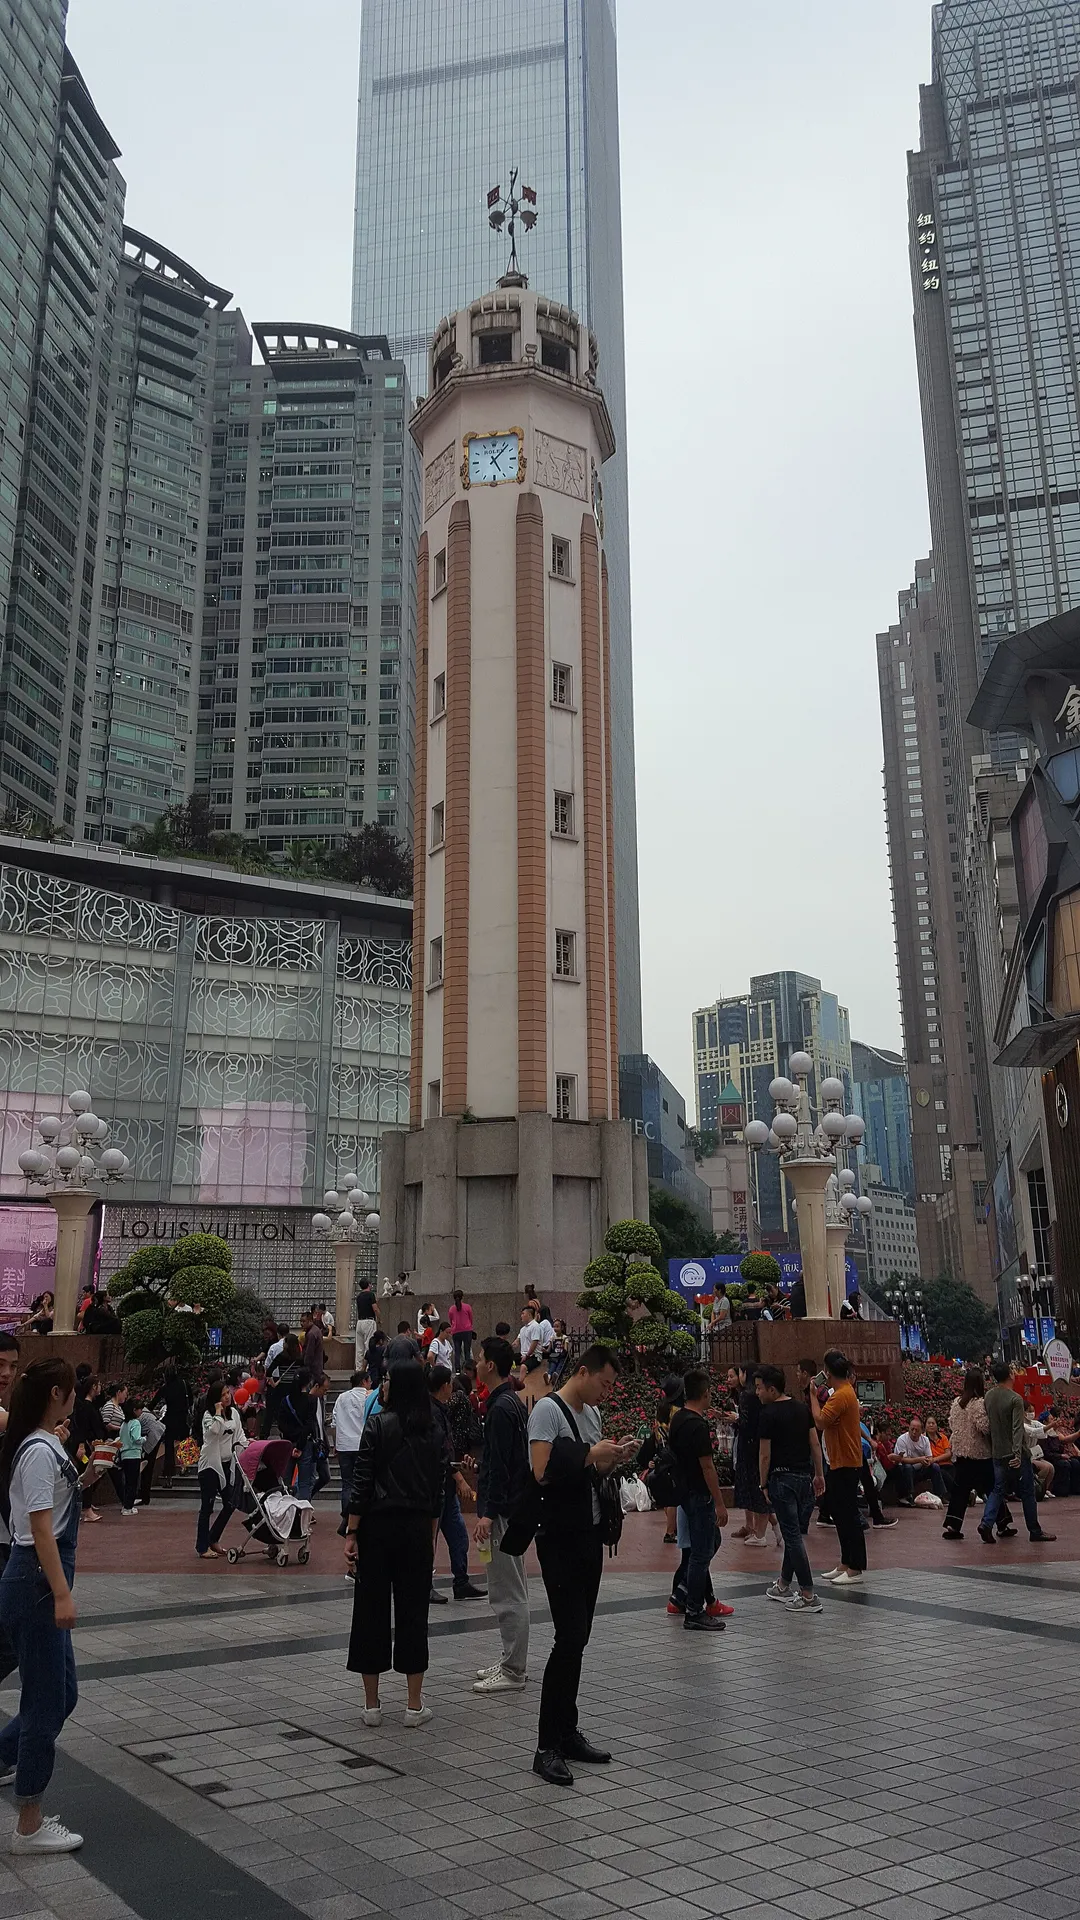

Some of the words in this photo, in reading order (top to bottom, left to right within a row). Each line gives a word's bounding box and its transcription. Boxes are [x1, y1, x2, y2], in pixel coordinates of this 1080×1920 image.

[916, 213, 940, 291] 纽约·纽约
[620, 1115, 656, 1140] FC
[121, 1220, 190, 1238] LOUIS
[199, 1222, 296, 1241] VUITTON
[720, 1265, 739, 1274] 2017
[783, 1263, 799, 1273] 重庆
